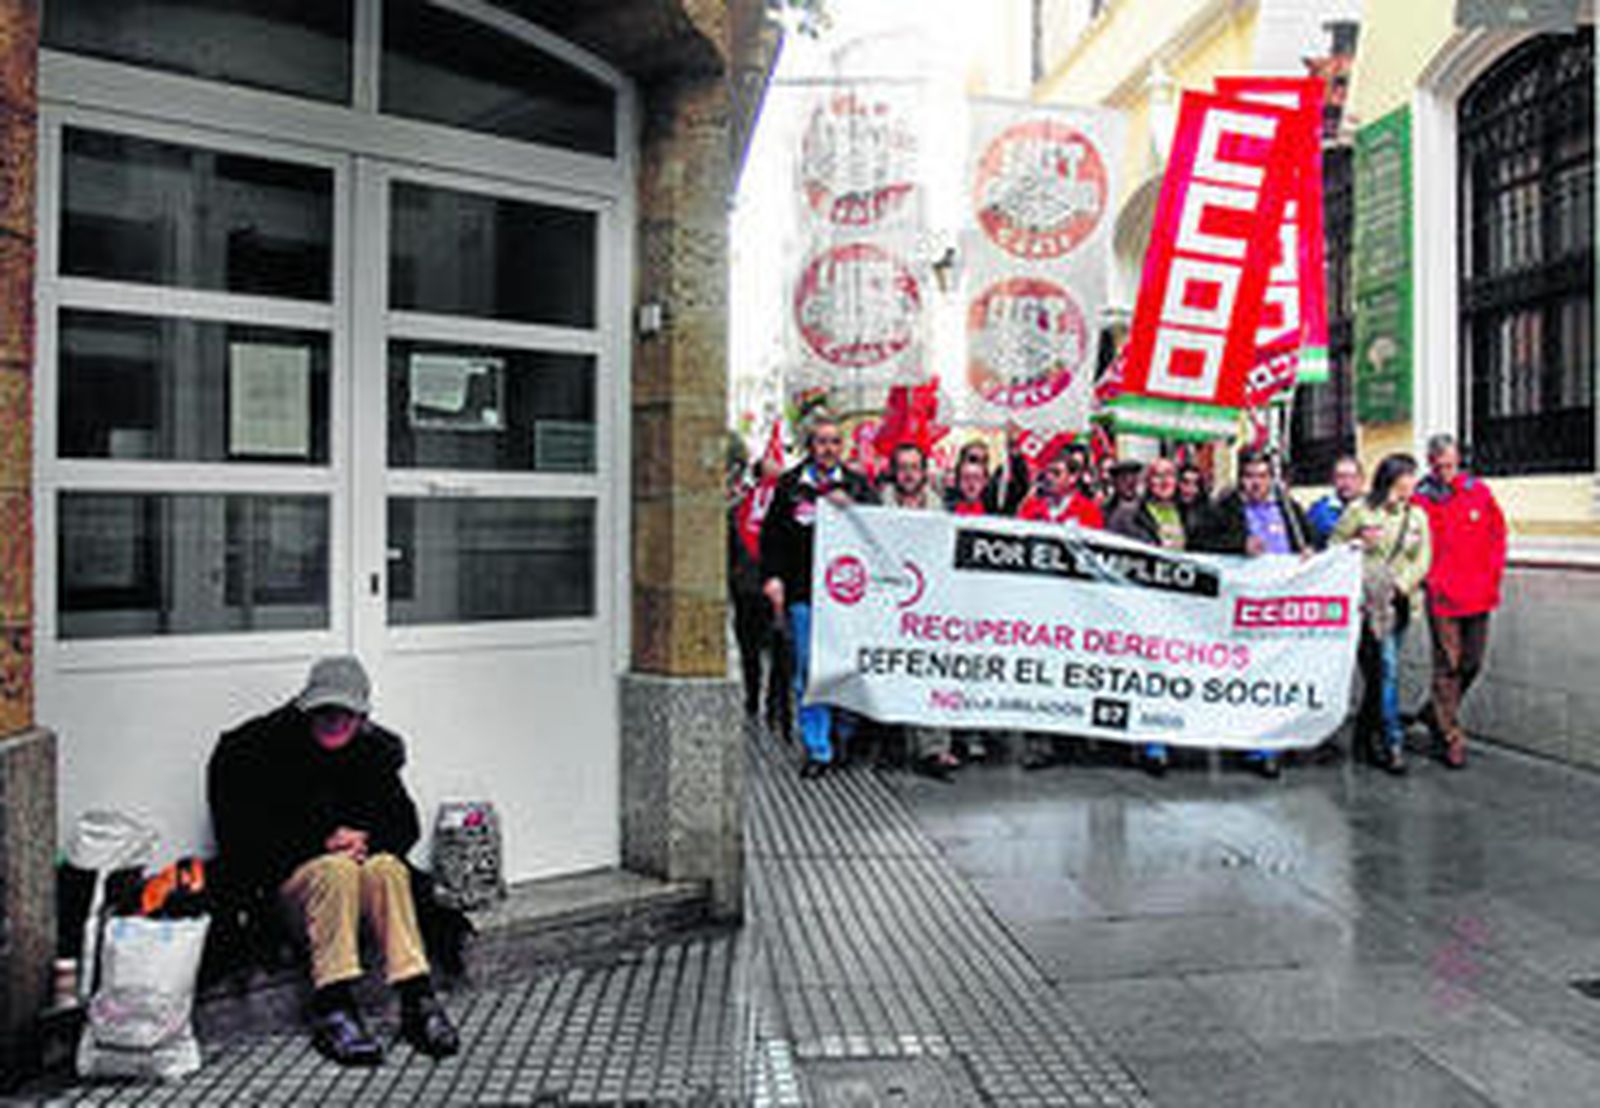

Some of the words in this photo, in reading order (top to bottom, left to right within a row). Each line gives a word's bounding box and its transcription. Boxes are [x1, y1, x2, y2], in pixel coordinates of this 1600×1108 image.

[1146, 108, 1279, 399] CCOO
[971, 539, 1024, 565] POR
[1031, 545, 1068, 570] EL
[901, 612, 1075, 651] RECUPERAR
[1083, 628, 1251, 669] DERECHOS
[1241, 602, 1320, 622] CCOO
[858, 647, 1006, 684] DEFENDER
[1014, 658, 1053, 685] EL
[1063, 663, 1193, 700] ESTADO
[1202, 677, 1323, 710] SOCIAL
